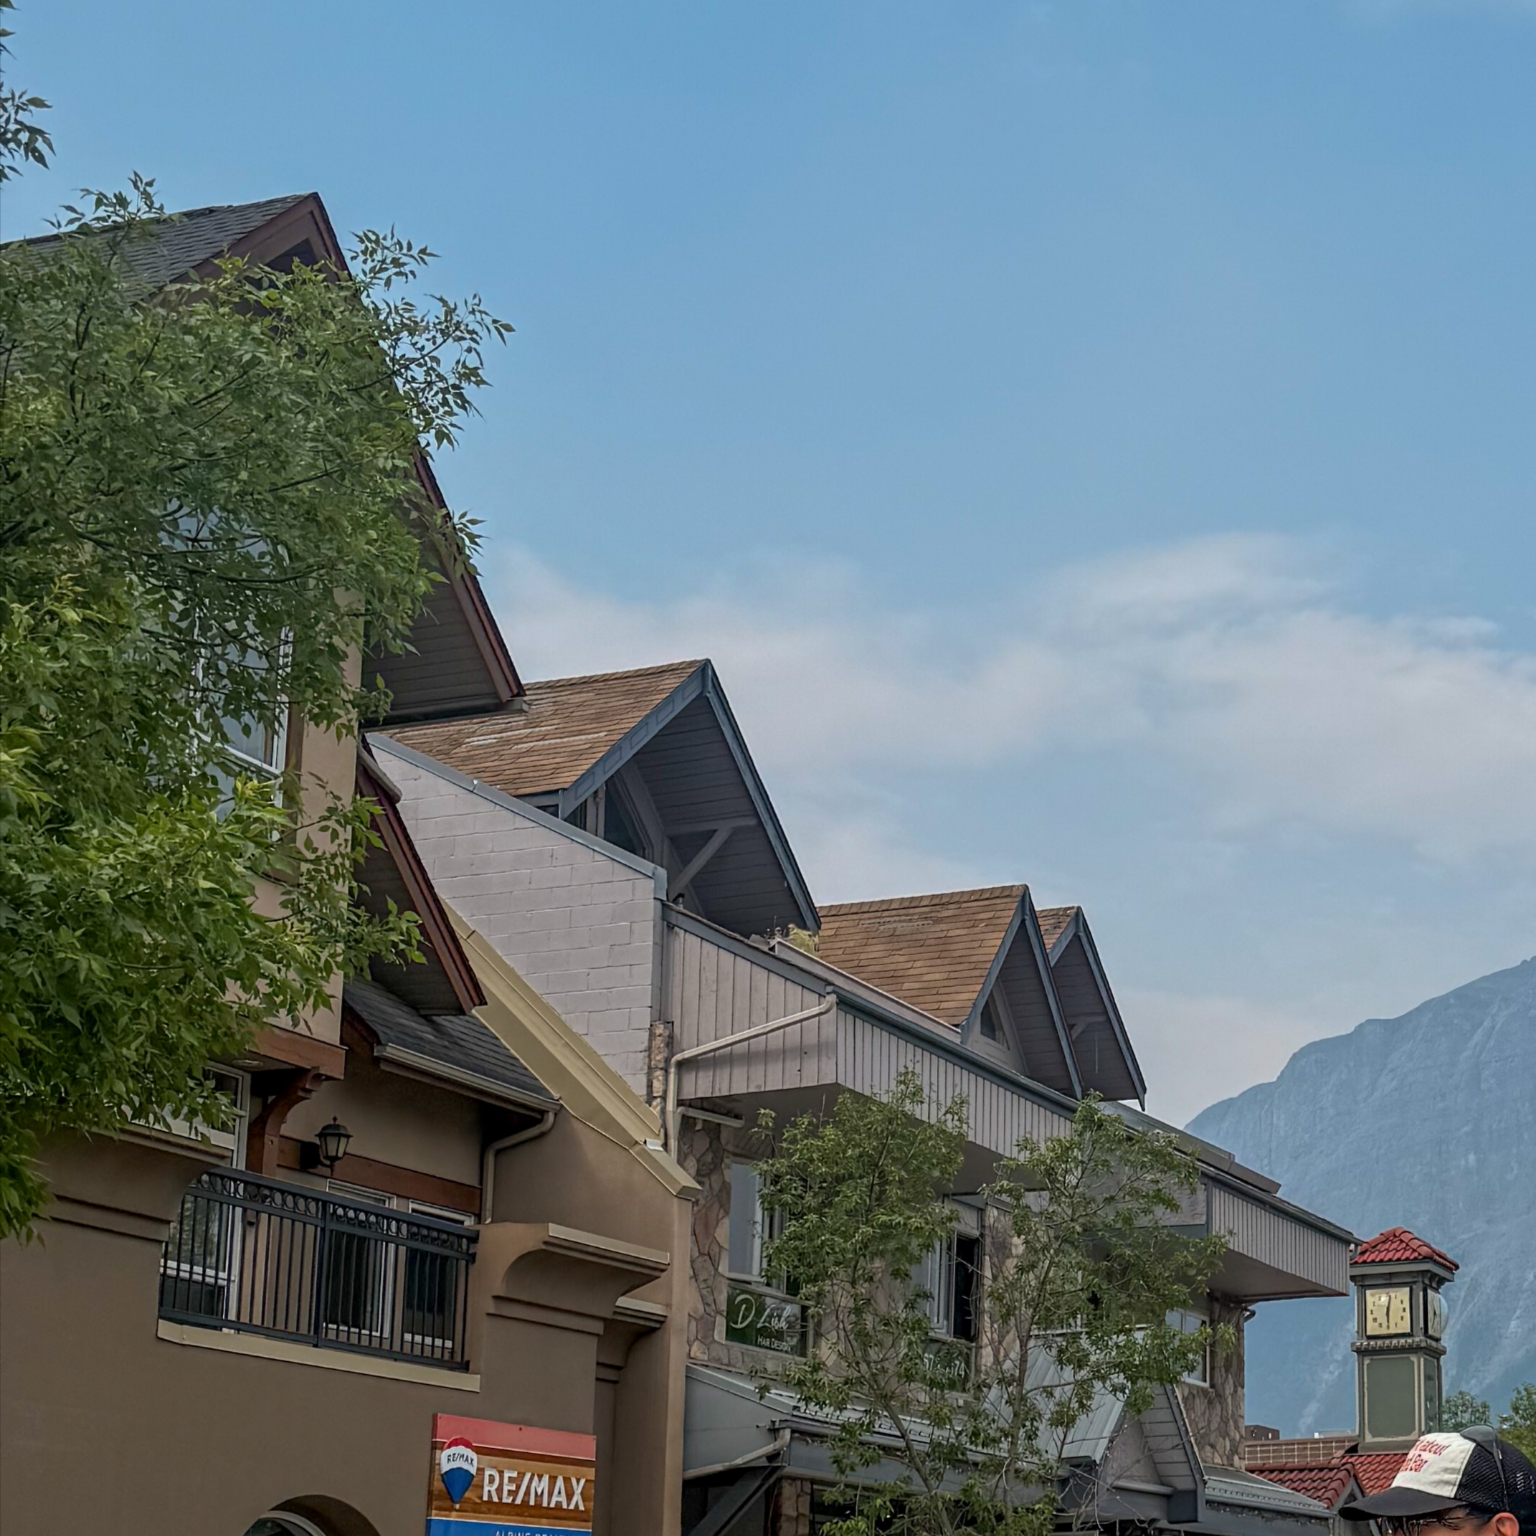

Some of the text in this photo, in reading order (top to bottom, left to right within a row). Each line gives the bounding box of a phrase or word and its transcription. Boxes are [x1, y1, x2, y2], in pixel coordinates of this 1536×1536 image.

[730, 1294, 756, 1330] D
[446, 1453, 475, 1467] RE/MAX
[482, 1467, 586, 1511] RE/MAX
